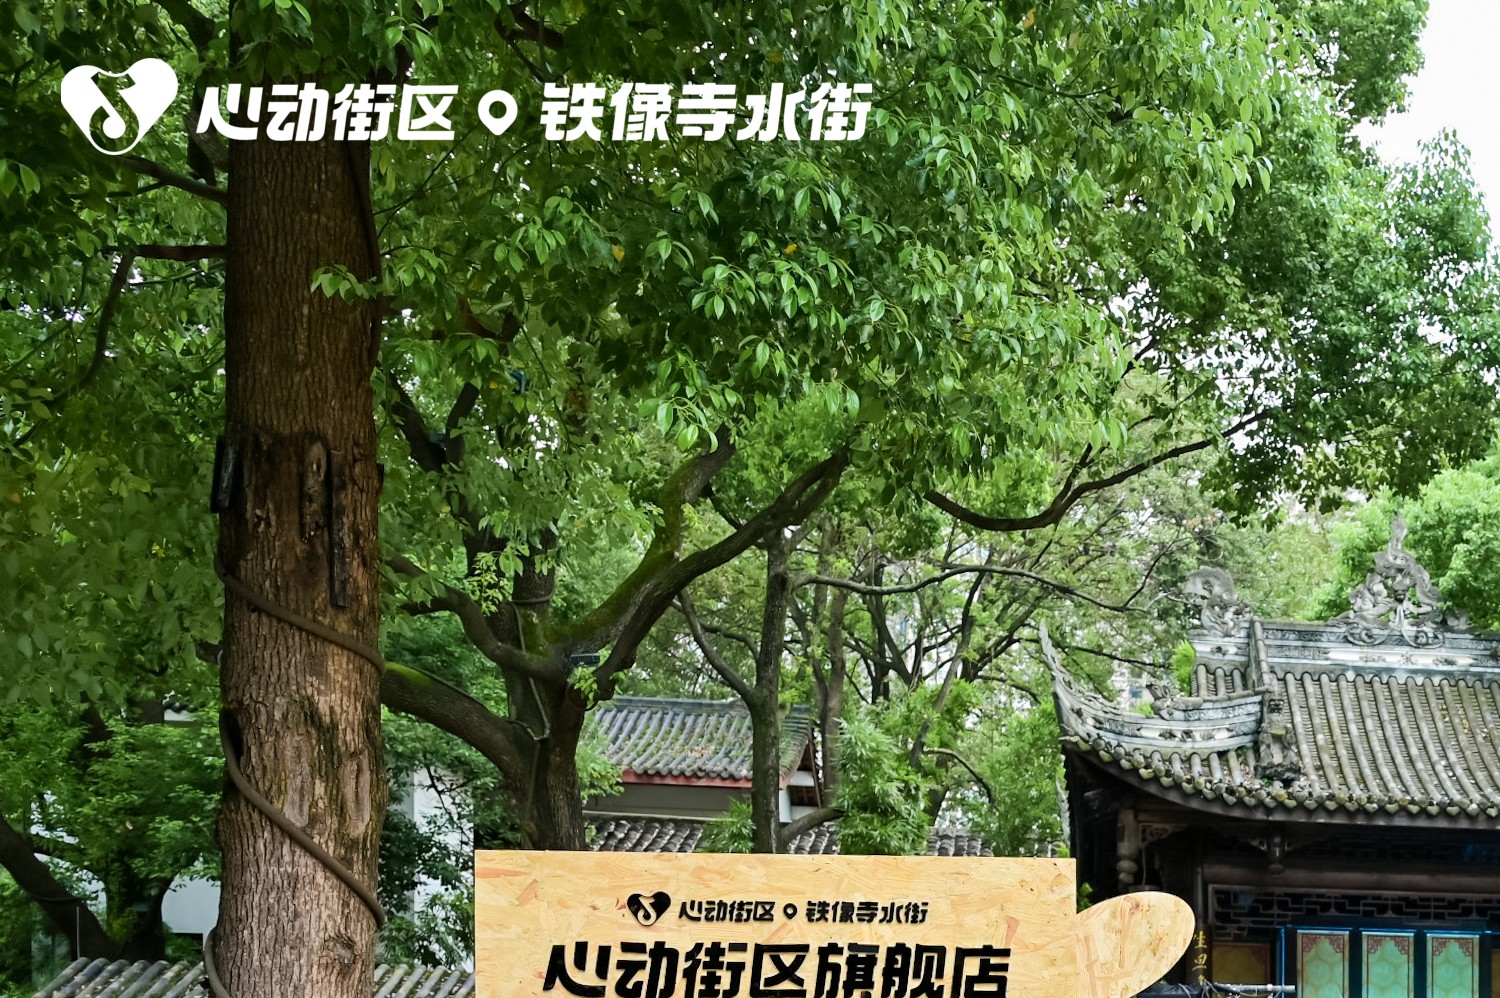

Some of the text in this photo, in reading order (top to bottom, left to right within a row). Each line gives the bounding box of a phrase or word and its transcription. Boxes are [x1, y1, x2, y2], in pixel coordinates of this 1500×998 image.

[678, 900, 928, 924] 心动街区 铁像寺水街
